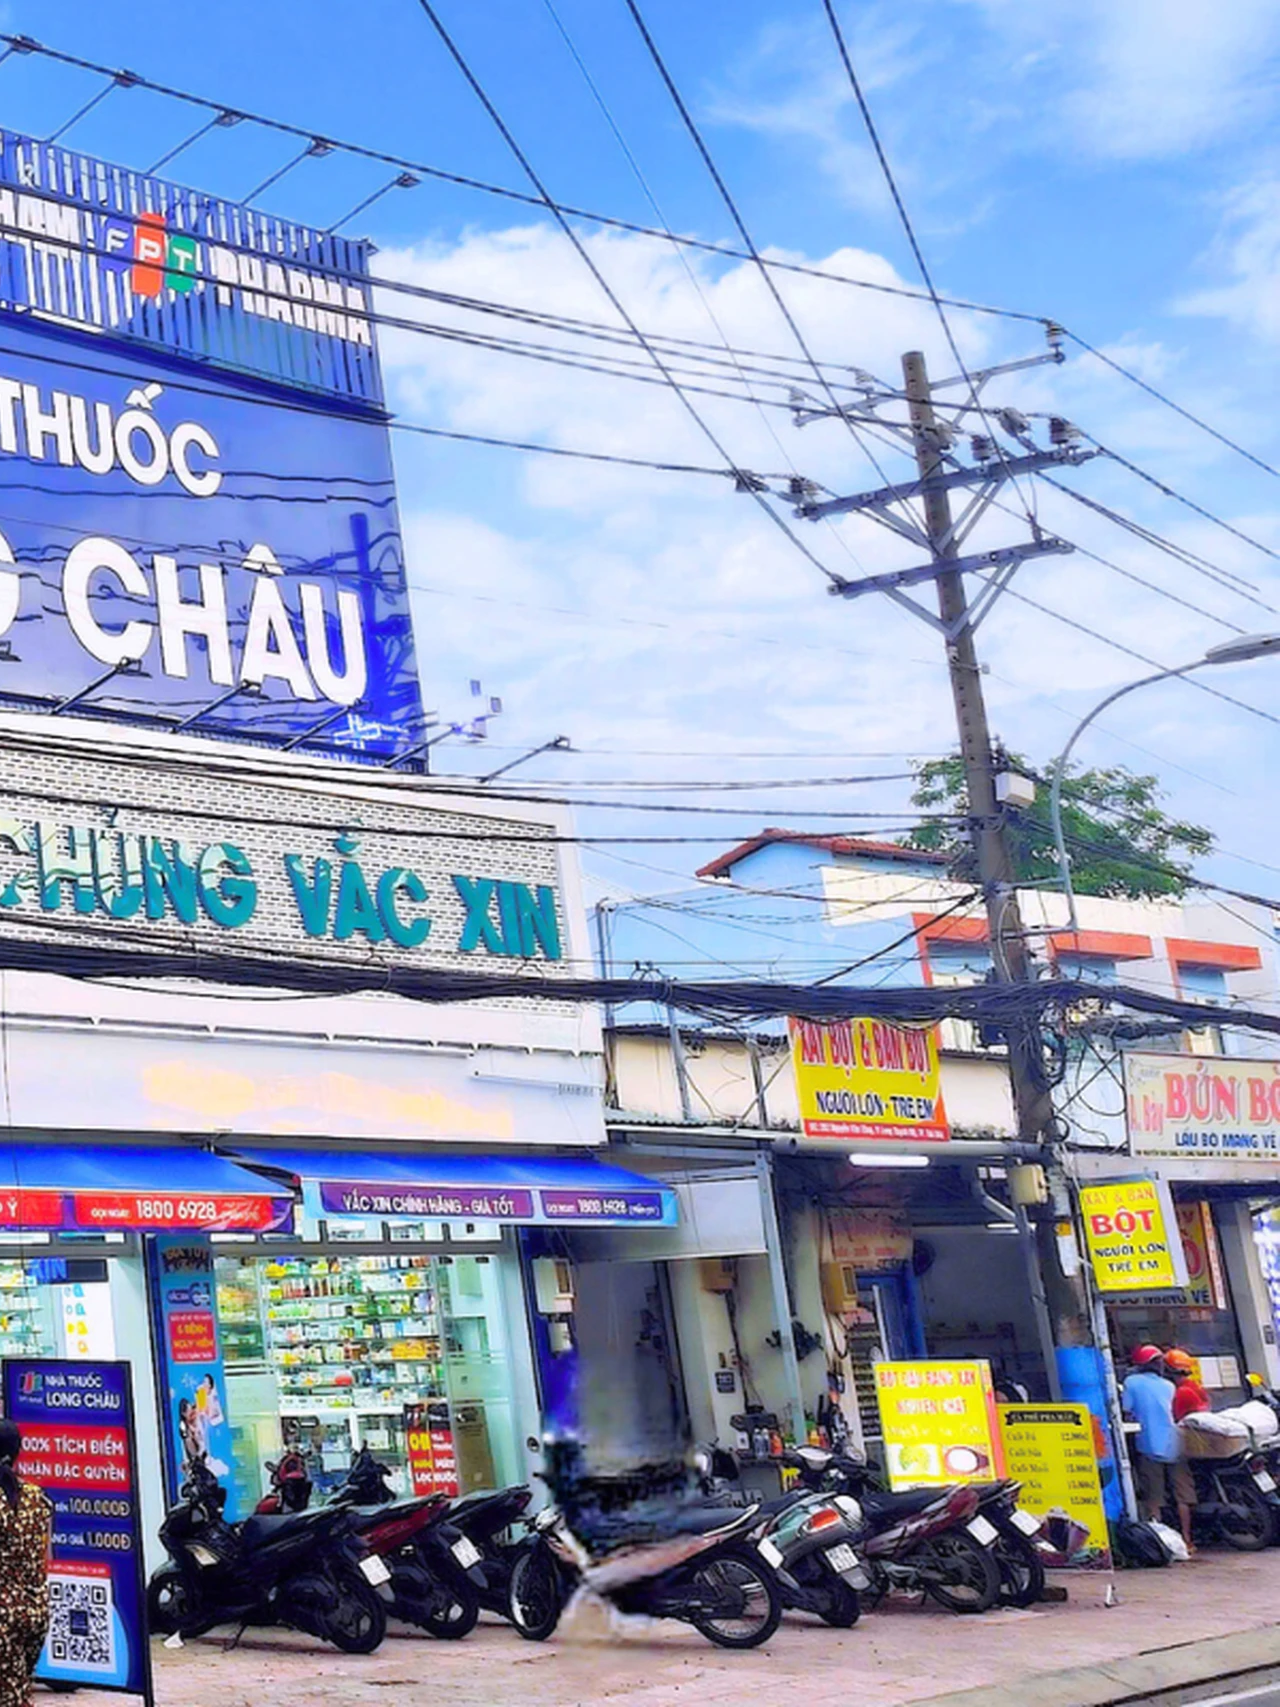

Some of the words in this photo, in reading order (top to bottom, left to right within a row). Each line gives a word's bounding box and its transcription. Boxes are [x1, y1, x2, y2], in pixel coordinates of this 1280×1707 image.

[211, 246, 372, 347] PHARMA
[61, 542, 369, 705] CHÂU
[284, 817, 432, 948] VẮC
[452, 875, 561, 960] XIN
[7, 1195, 18, 1217] Ý
[136, 1199, 174, 1219] 1800
[177, 1199, 217, 1220] 6928
[392, 1192, 428, 1214] CHÍNH
[1090, 1205, 1155, 1239] BỘT
[45, 1373, 67, 1388] NHÀ
[67, 1371, 102, 1389] THUỐC
[46, 1391, 82, 1408] LONG
[83, 1390, 121, 1410] CHÂU
[20, 1435, 50, 1452] 00%
[54, 1434, 87, 1454] TÍCH
[90, 1433, 125, 1456] ĐIỂM
[18, 1459, 52, 1480] NHẬN
[54, 1461, 81, 1482] ĐẶC
[84, 1460, 126, 1482] QUYỀN
